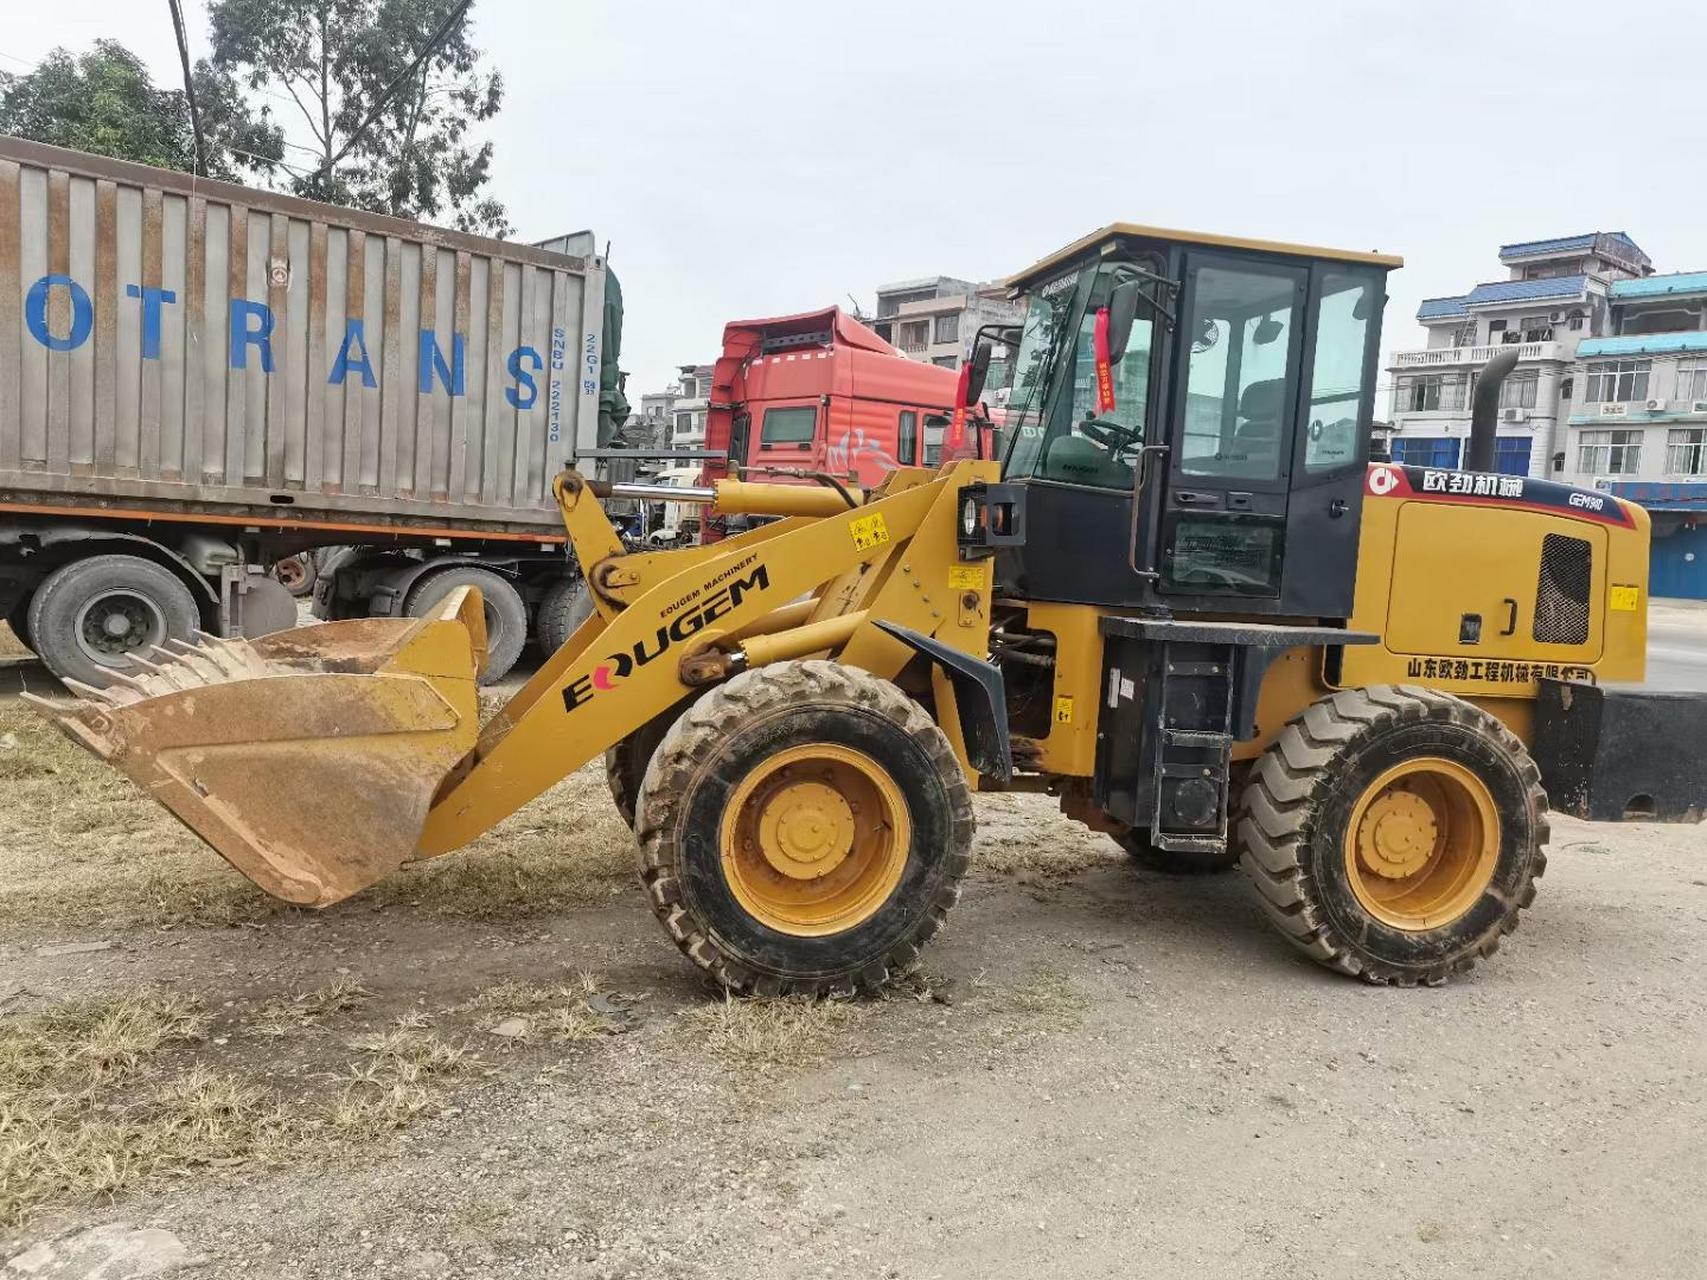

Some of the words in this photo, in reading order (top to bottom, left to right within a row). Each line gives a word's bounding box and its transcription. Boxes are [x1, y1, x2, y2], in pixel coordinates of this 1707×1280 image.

[25, 273, 543, 410] OTRANS
[552, 327, 565, 370] SNBU
[585, 333, 598, 374] 22G1
[550, 380, 561, 442] 222130
[1422, 470, 1523, 497] 欧劲机械
[703, 552, 759, 591] MACHINERY
[561, 563, 770, 713] EOUGEM
